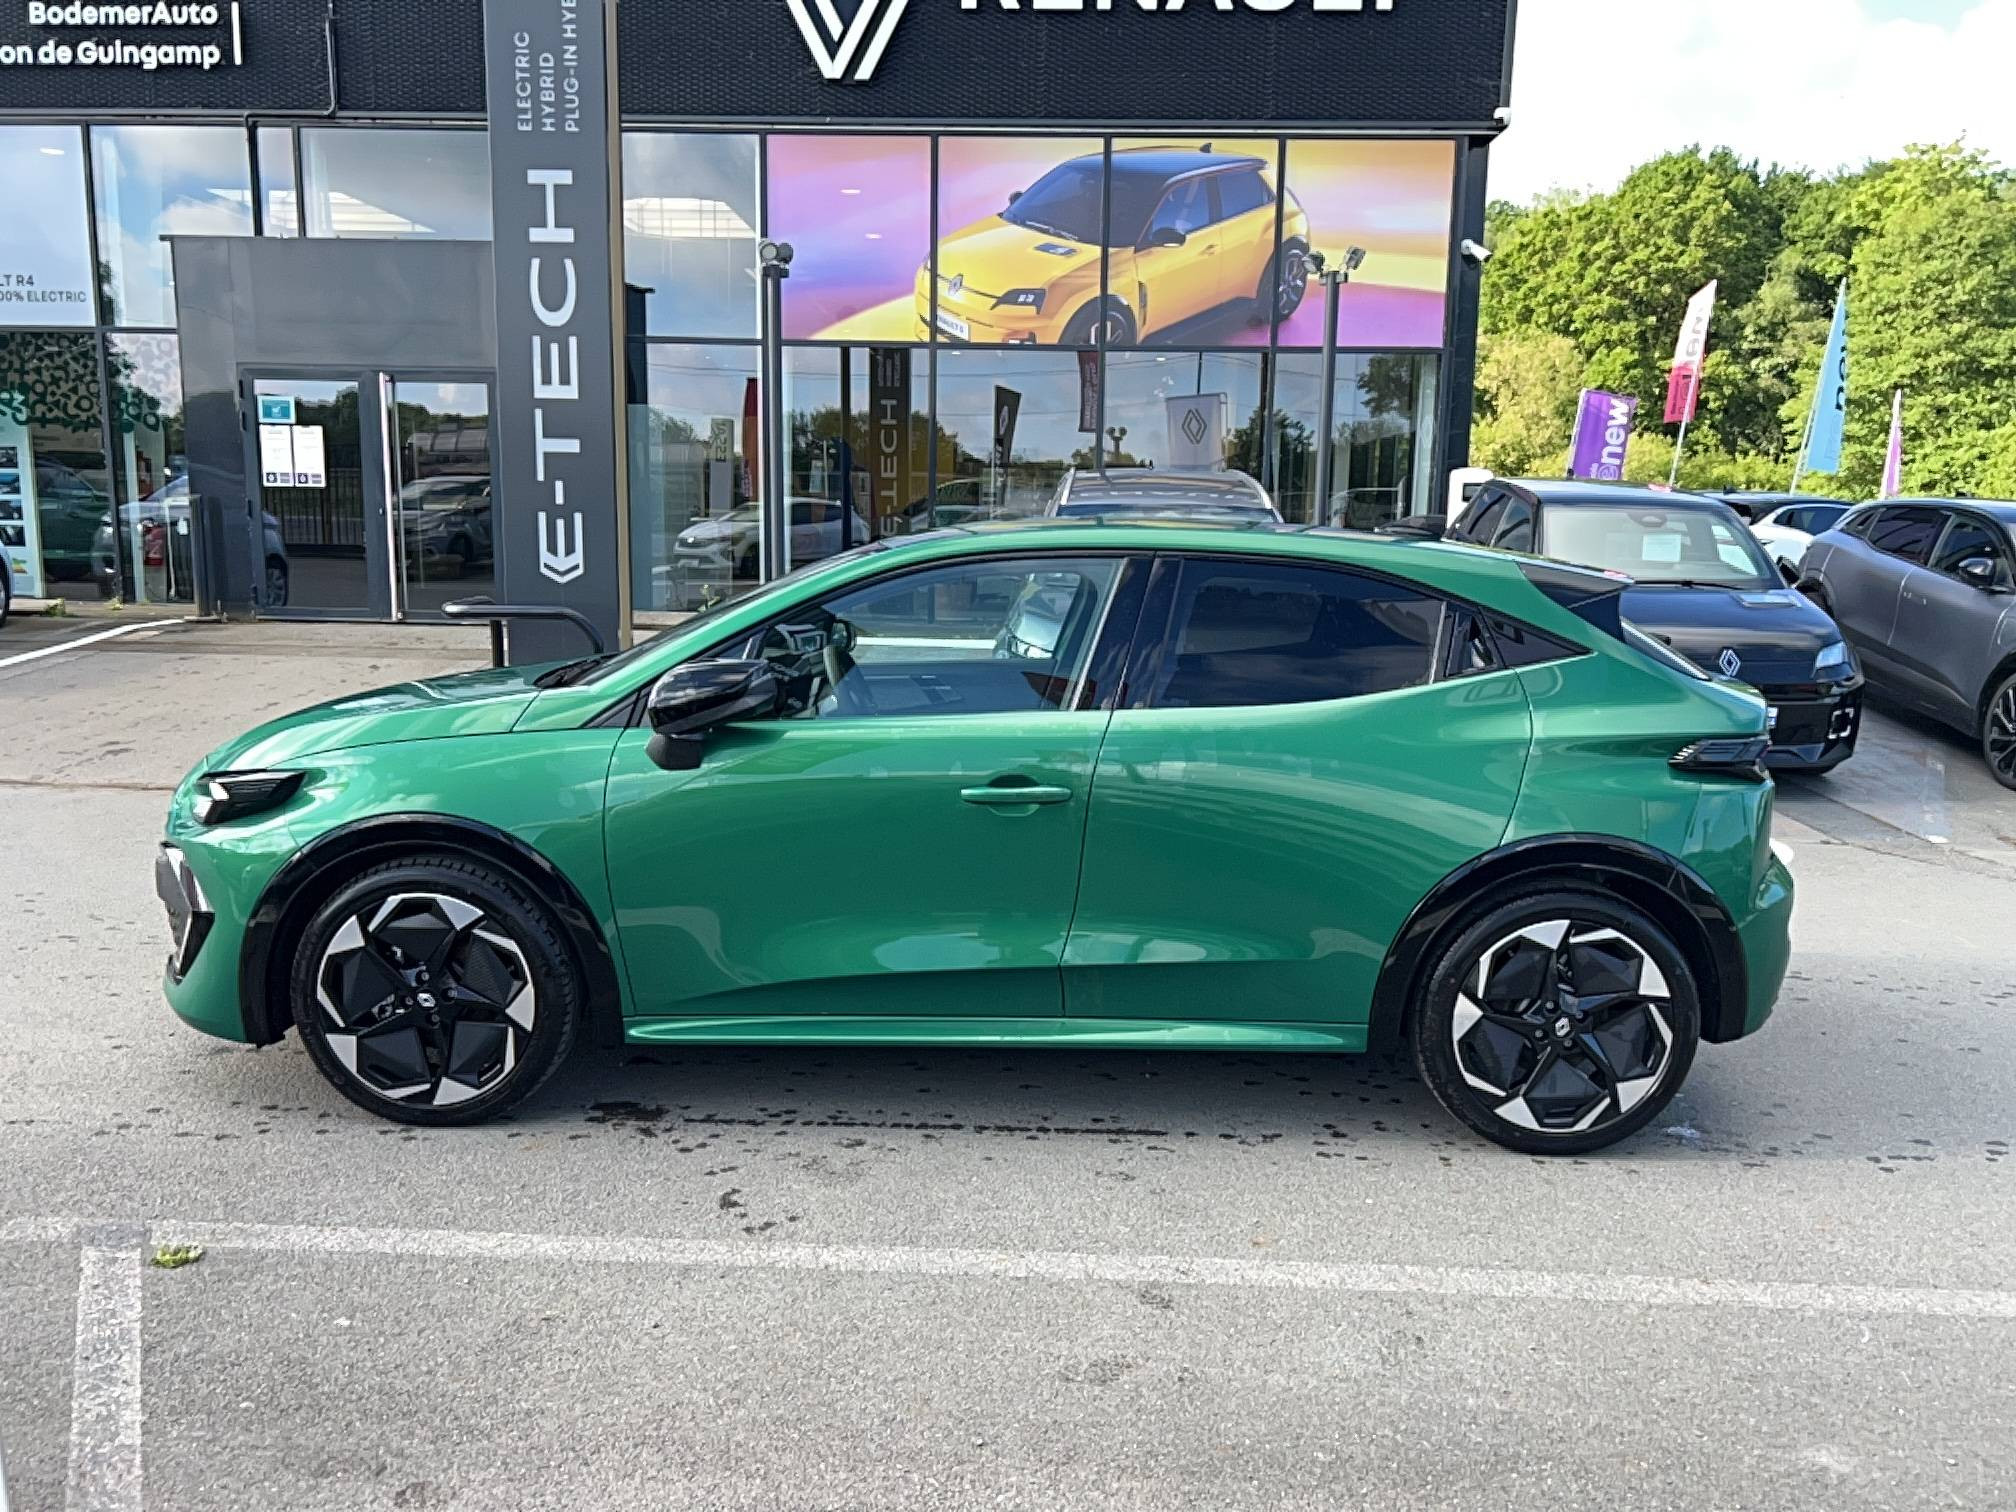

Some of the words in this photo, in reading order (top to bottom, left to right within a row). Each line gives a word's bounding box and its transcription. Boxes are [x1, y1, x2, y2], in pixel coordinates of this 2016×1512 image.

[28, 1, 219, 25] BodemerAuto
[38, 40, 72, 64] de
[77, 39, 221, 70] Guingamp
[513, 31, 533, 132] ELECTRIC
[539, 52, 556, 132] HYBRID
[562, 44, 580, 132] PLUG-IN
[27, 290, 87, 302] ELECTRIC
[526, 168, 585, 584] E-TECH
